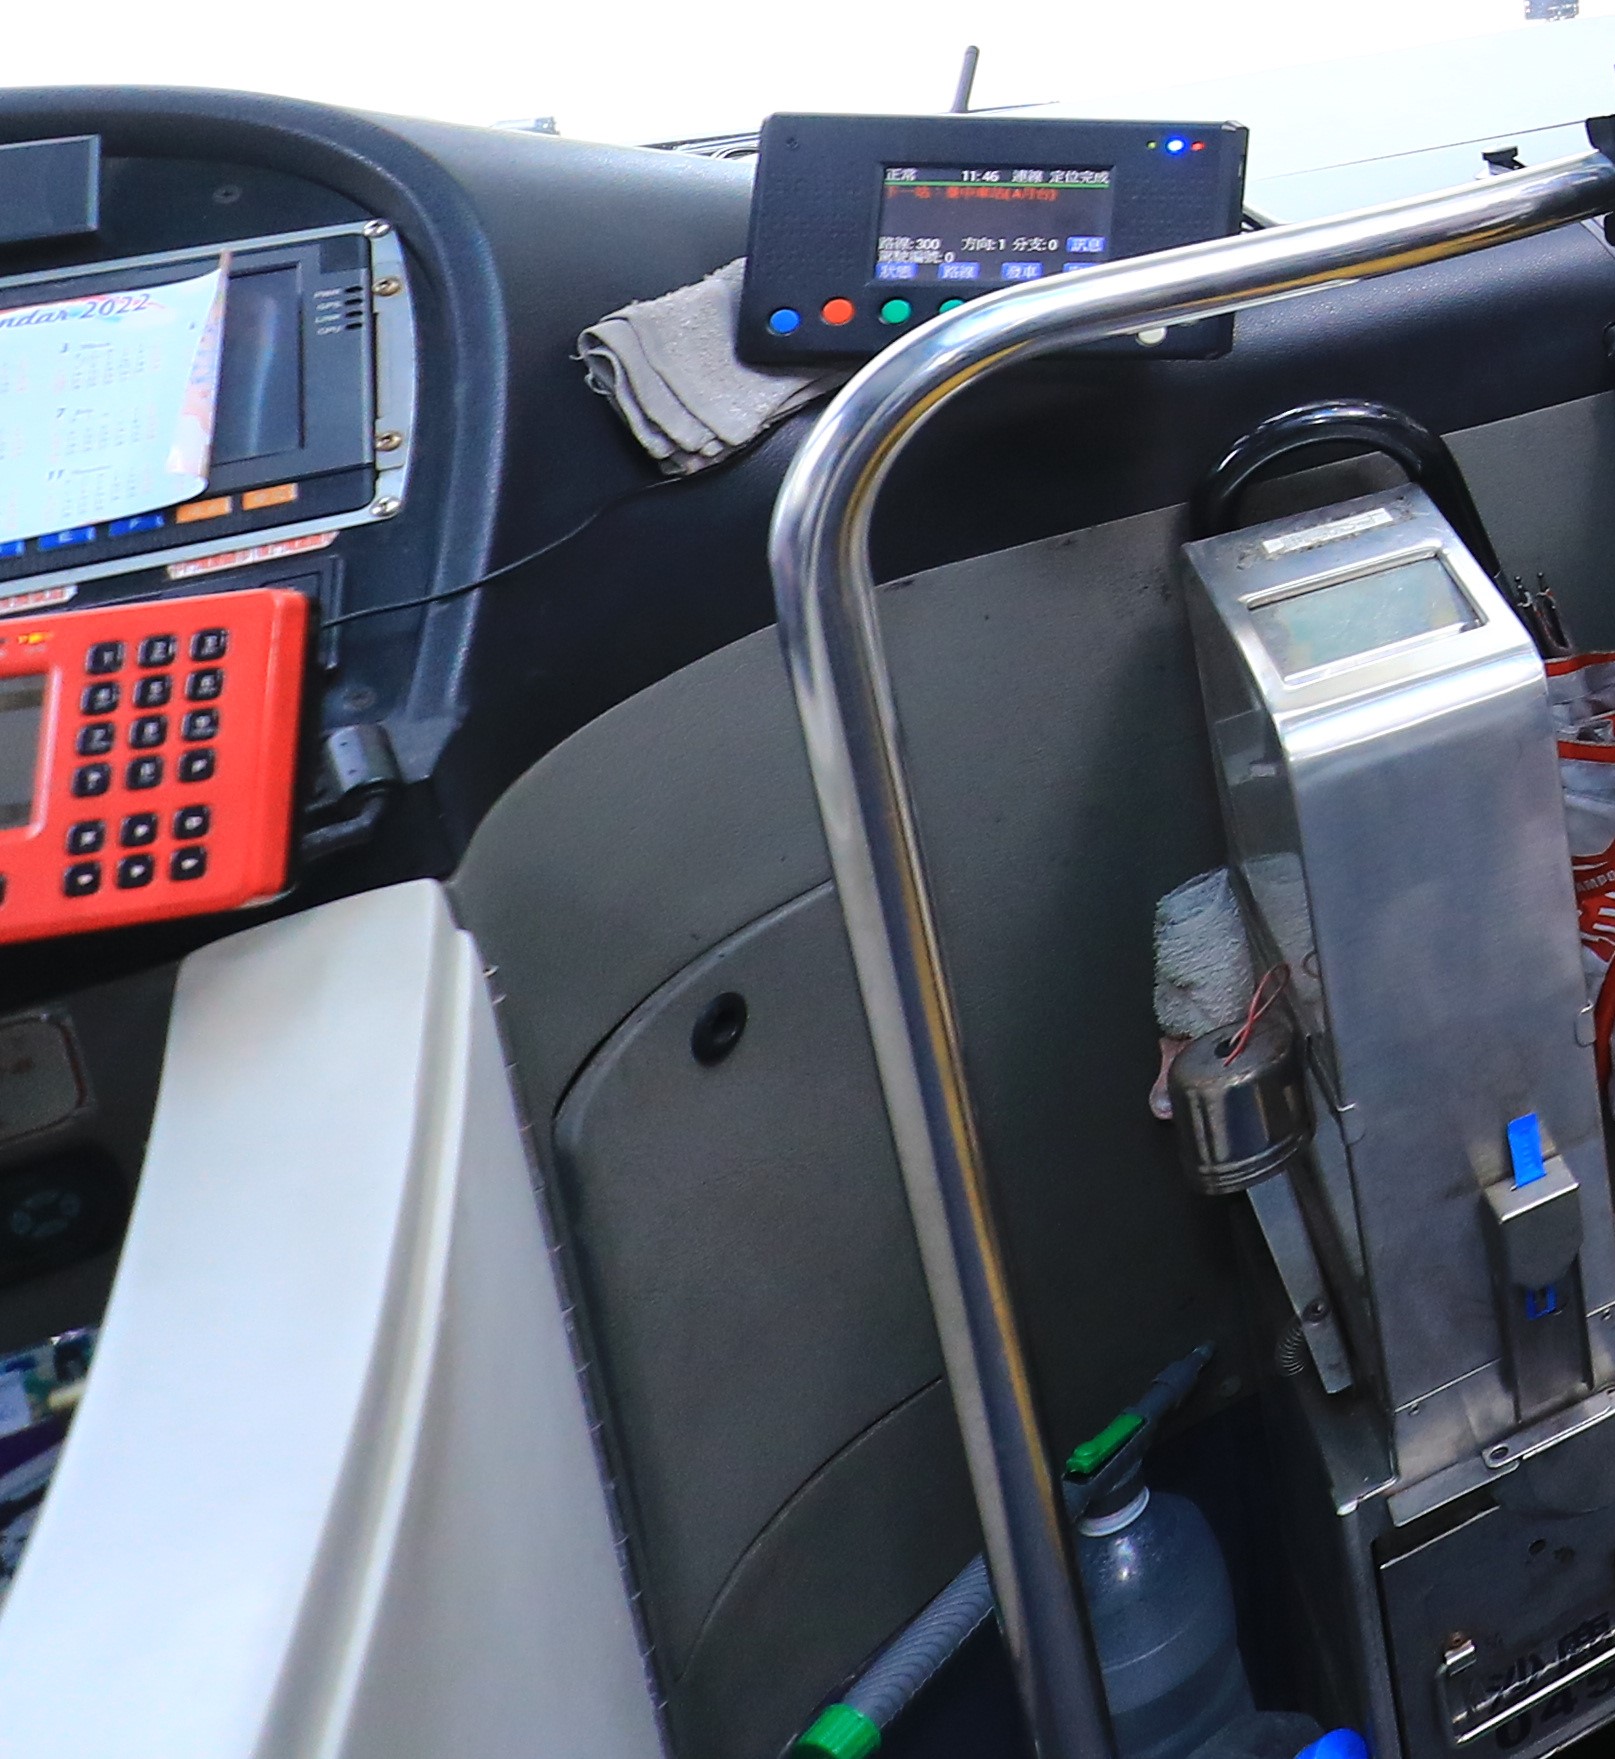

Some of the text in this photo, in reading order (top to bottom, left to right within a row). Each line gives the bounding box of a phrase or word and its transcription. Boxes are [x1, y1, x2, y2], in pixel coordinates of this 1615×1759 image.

[961, 170, 1000, 183] 11:46
[1049, 170, 1110, 184] 定位完成
[80, 293, 151, 320] 2022
